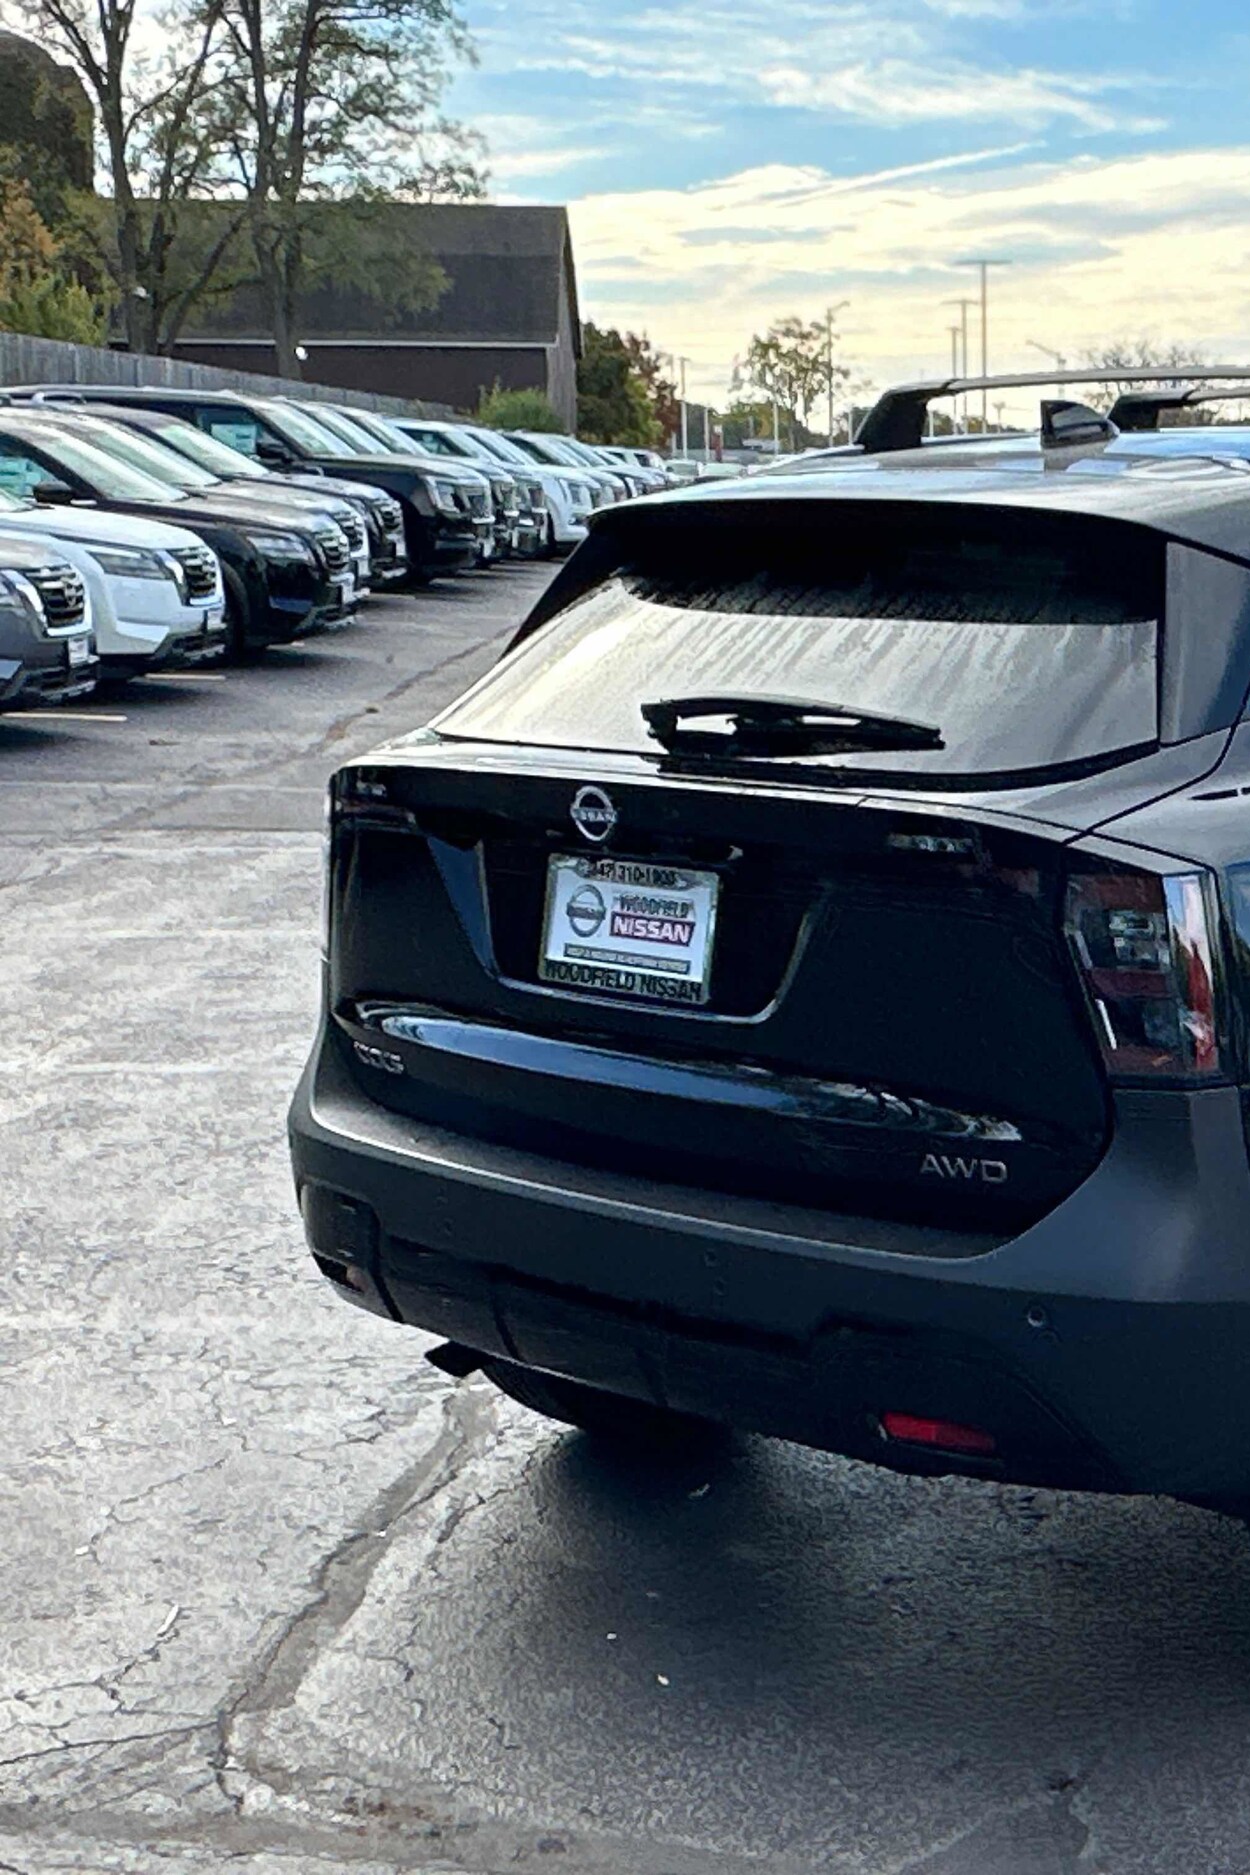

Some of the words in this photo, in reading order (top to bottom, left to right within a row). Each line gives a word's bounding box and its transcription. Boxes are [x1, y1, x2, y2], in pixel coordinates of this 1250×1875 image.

[613, 916, 691, 943] NISSAN
[544, 960, 636, 990] WOODFIELD
[639, 974, 702, 1001] NISSAN
[921, 1153, 1008, 1183] AWD
